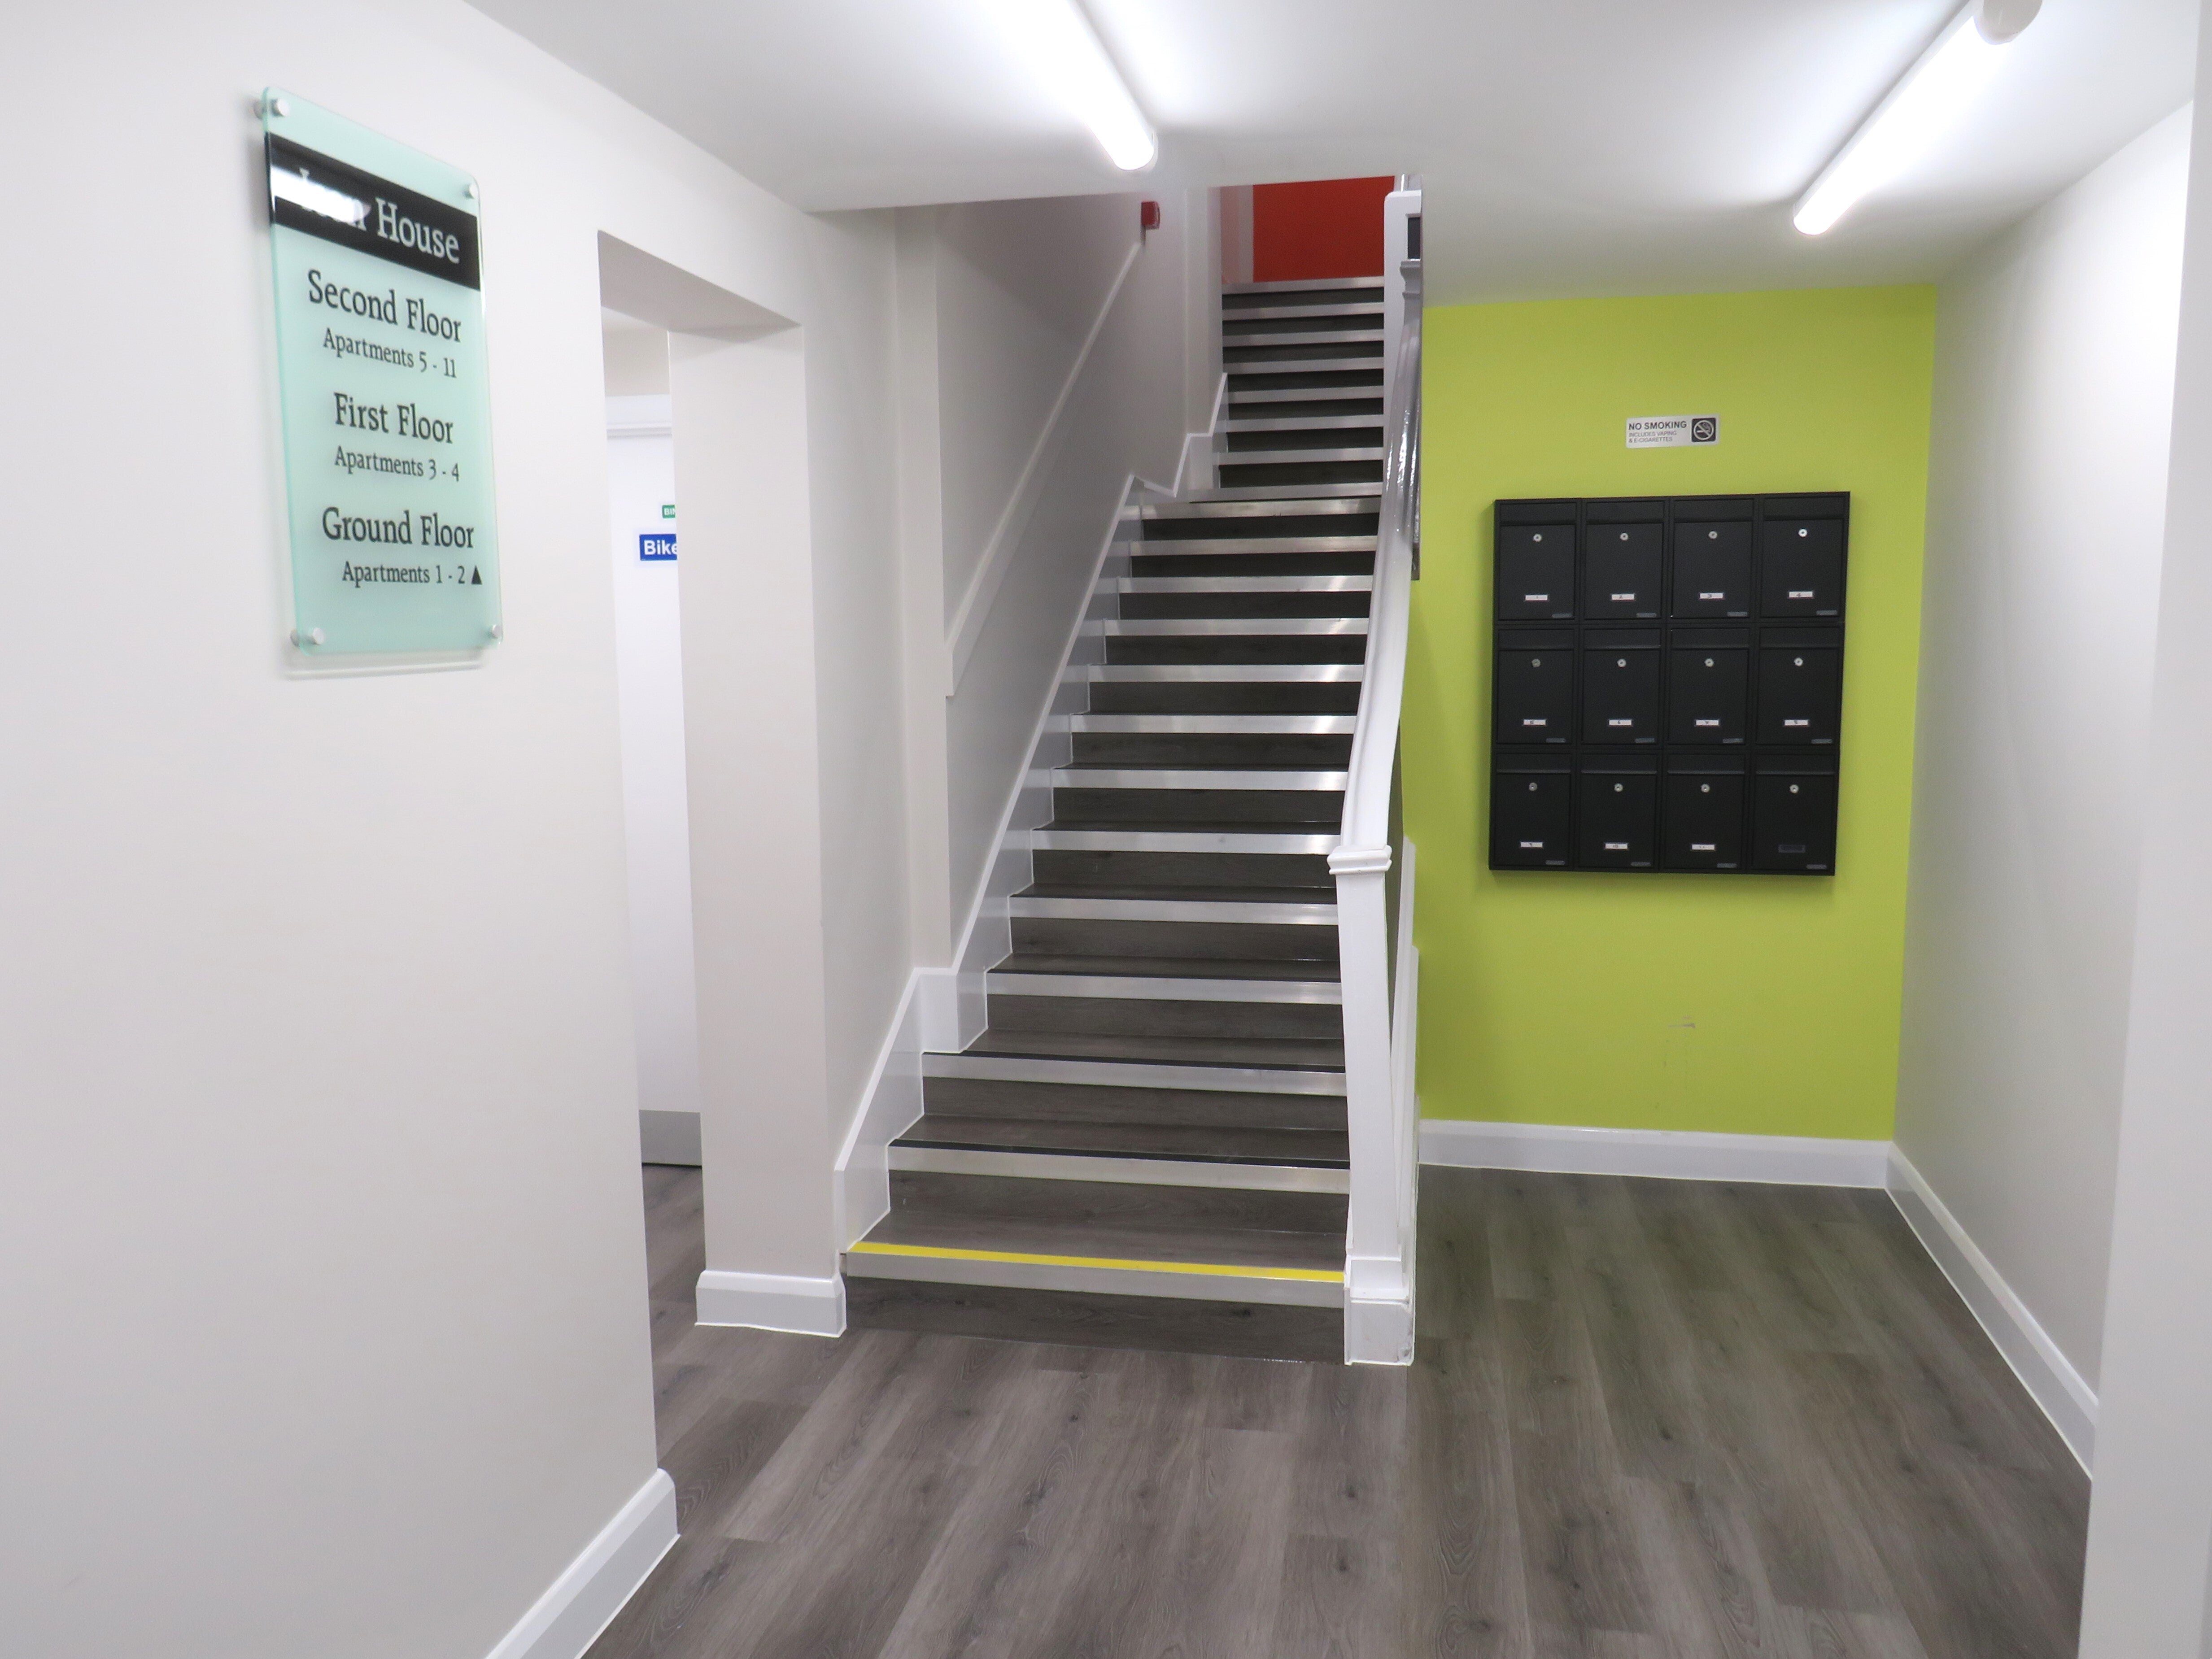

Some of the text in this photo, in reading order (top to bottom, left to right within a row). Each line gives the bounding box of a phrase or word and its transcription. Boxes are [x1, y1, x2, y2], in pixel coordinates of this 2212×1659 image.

[375, 196, 459, 264] House
[308, 269, 462, 343] Second Floor
[323, 327, 414, 369] Apartments
[419, 351, 427, 373] 5
[444, 357, 457, 378] 11
[334, 392, 454, 444] First Floor
[1628, 420, 1687, 431] NO SMOKING
[334, 445, 423, 476] Apartments
[429, 461, 436, 480] 3
[452, 463, 459, 482] 4
[322, 506, 475, 548] Ground Floor
[644, 540, 677, 555] Bike
[342, 561, 430, 588] Apartments
[435, 565, 442, 583] 1
[458, 566, 466, 583] 2
